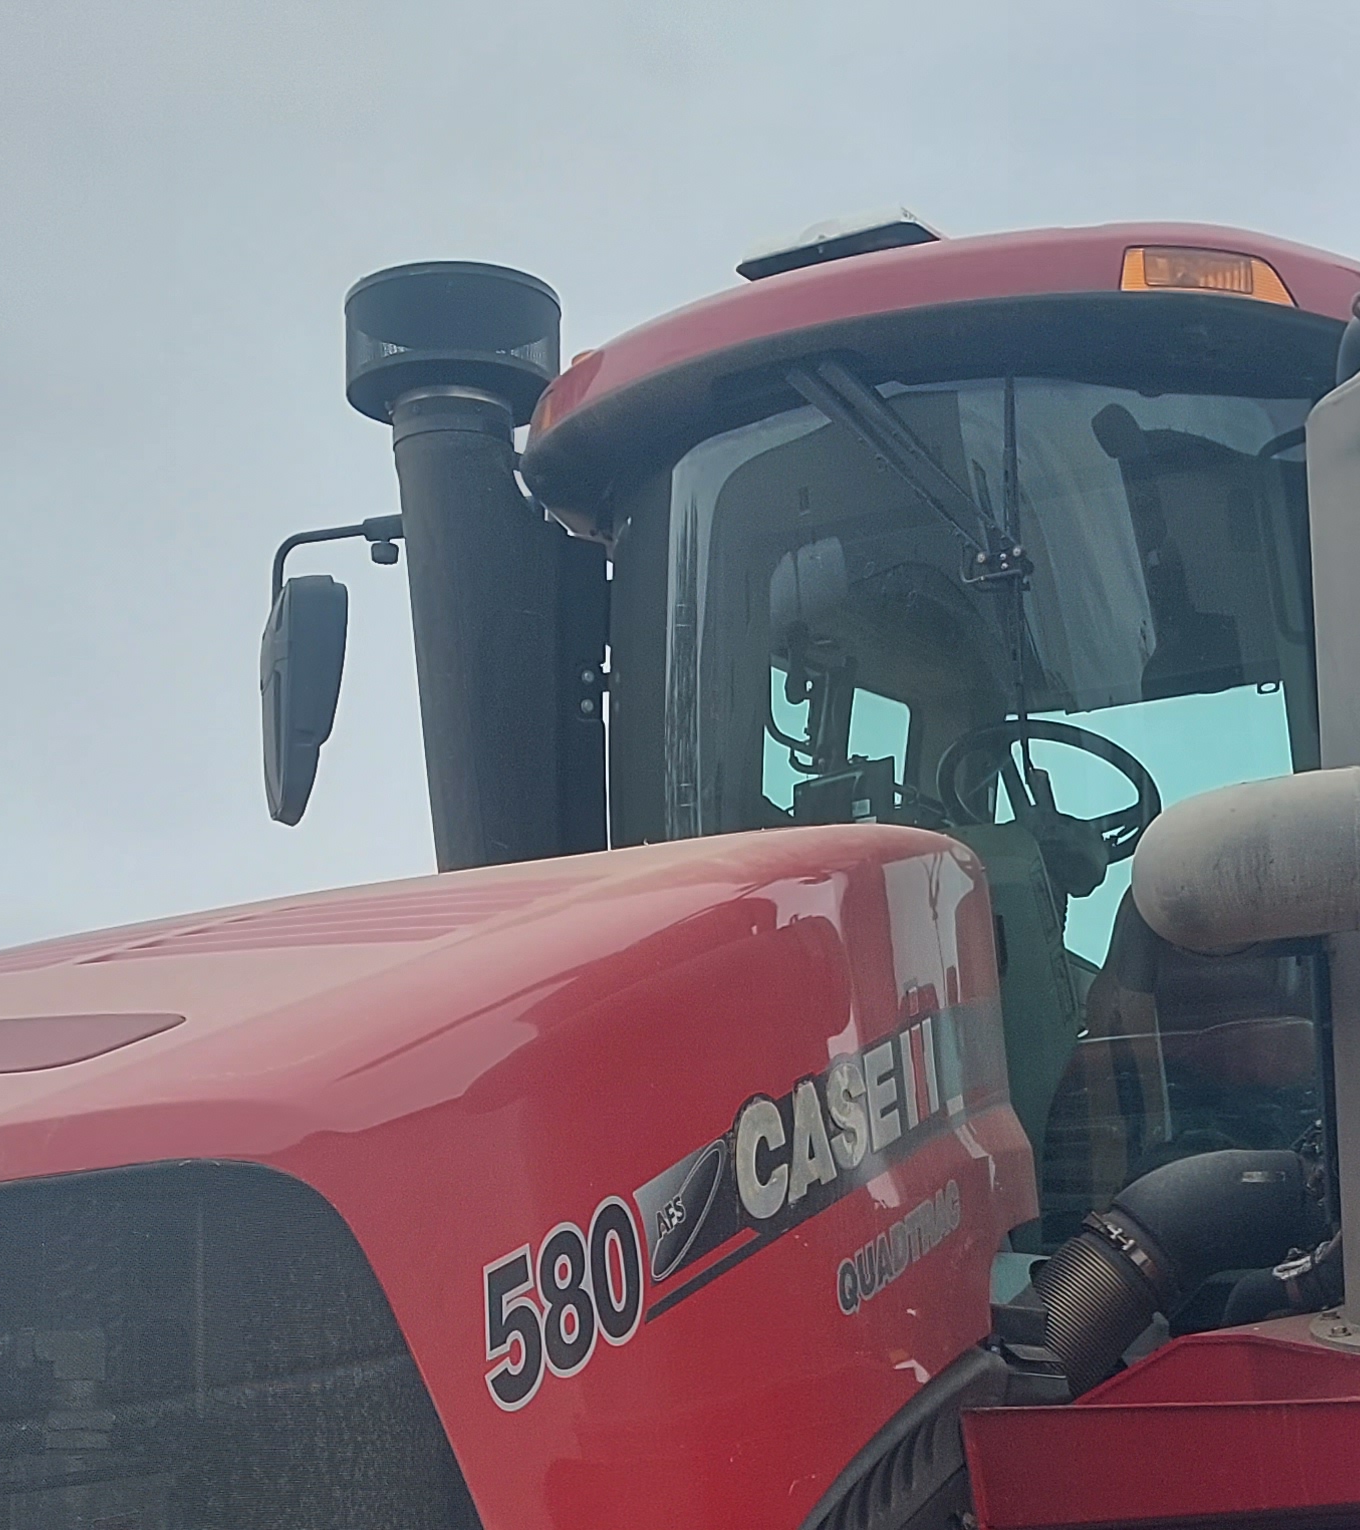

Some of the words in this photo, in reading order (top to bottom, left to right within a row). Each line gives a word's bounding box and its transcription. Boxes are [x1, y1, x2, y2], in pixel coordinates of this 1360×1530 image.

[735, 1041, 902, 1219] CASE
[655, 1195, 687, 1240] AFS
[836, 1179, 961, 1316] QUADTRAC
[484, 1195, 645, 1412] 580
